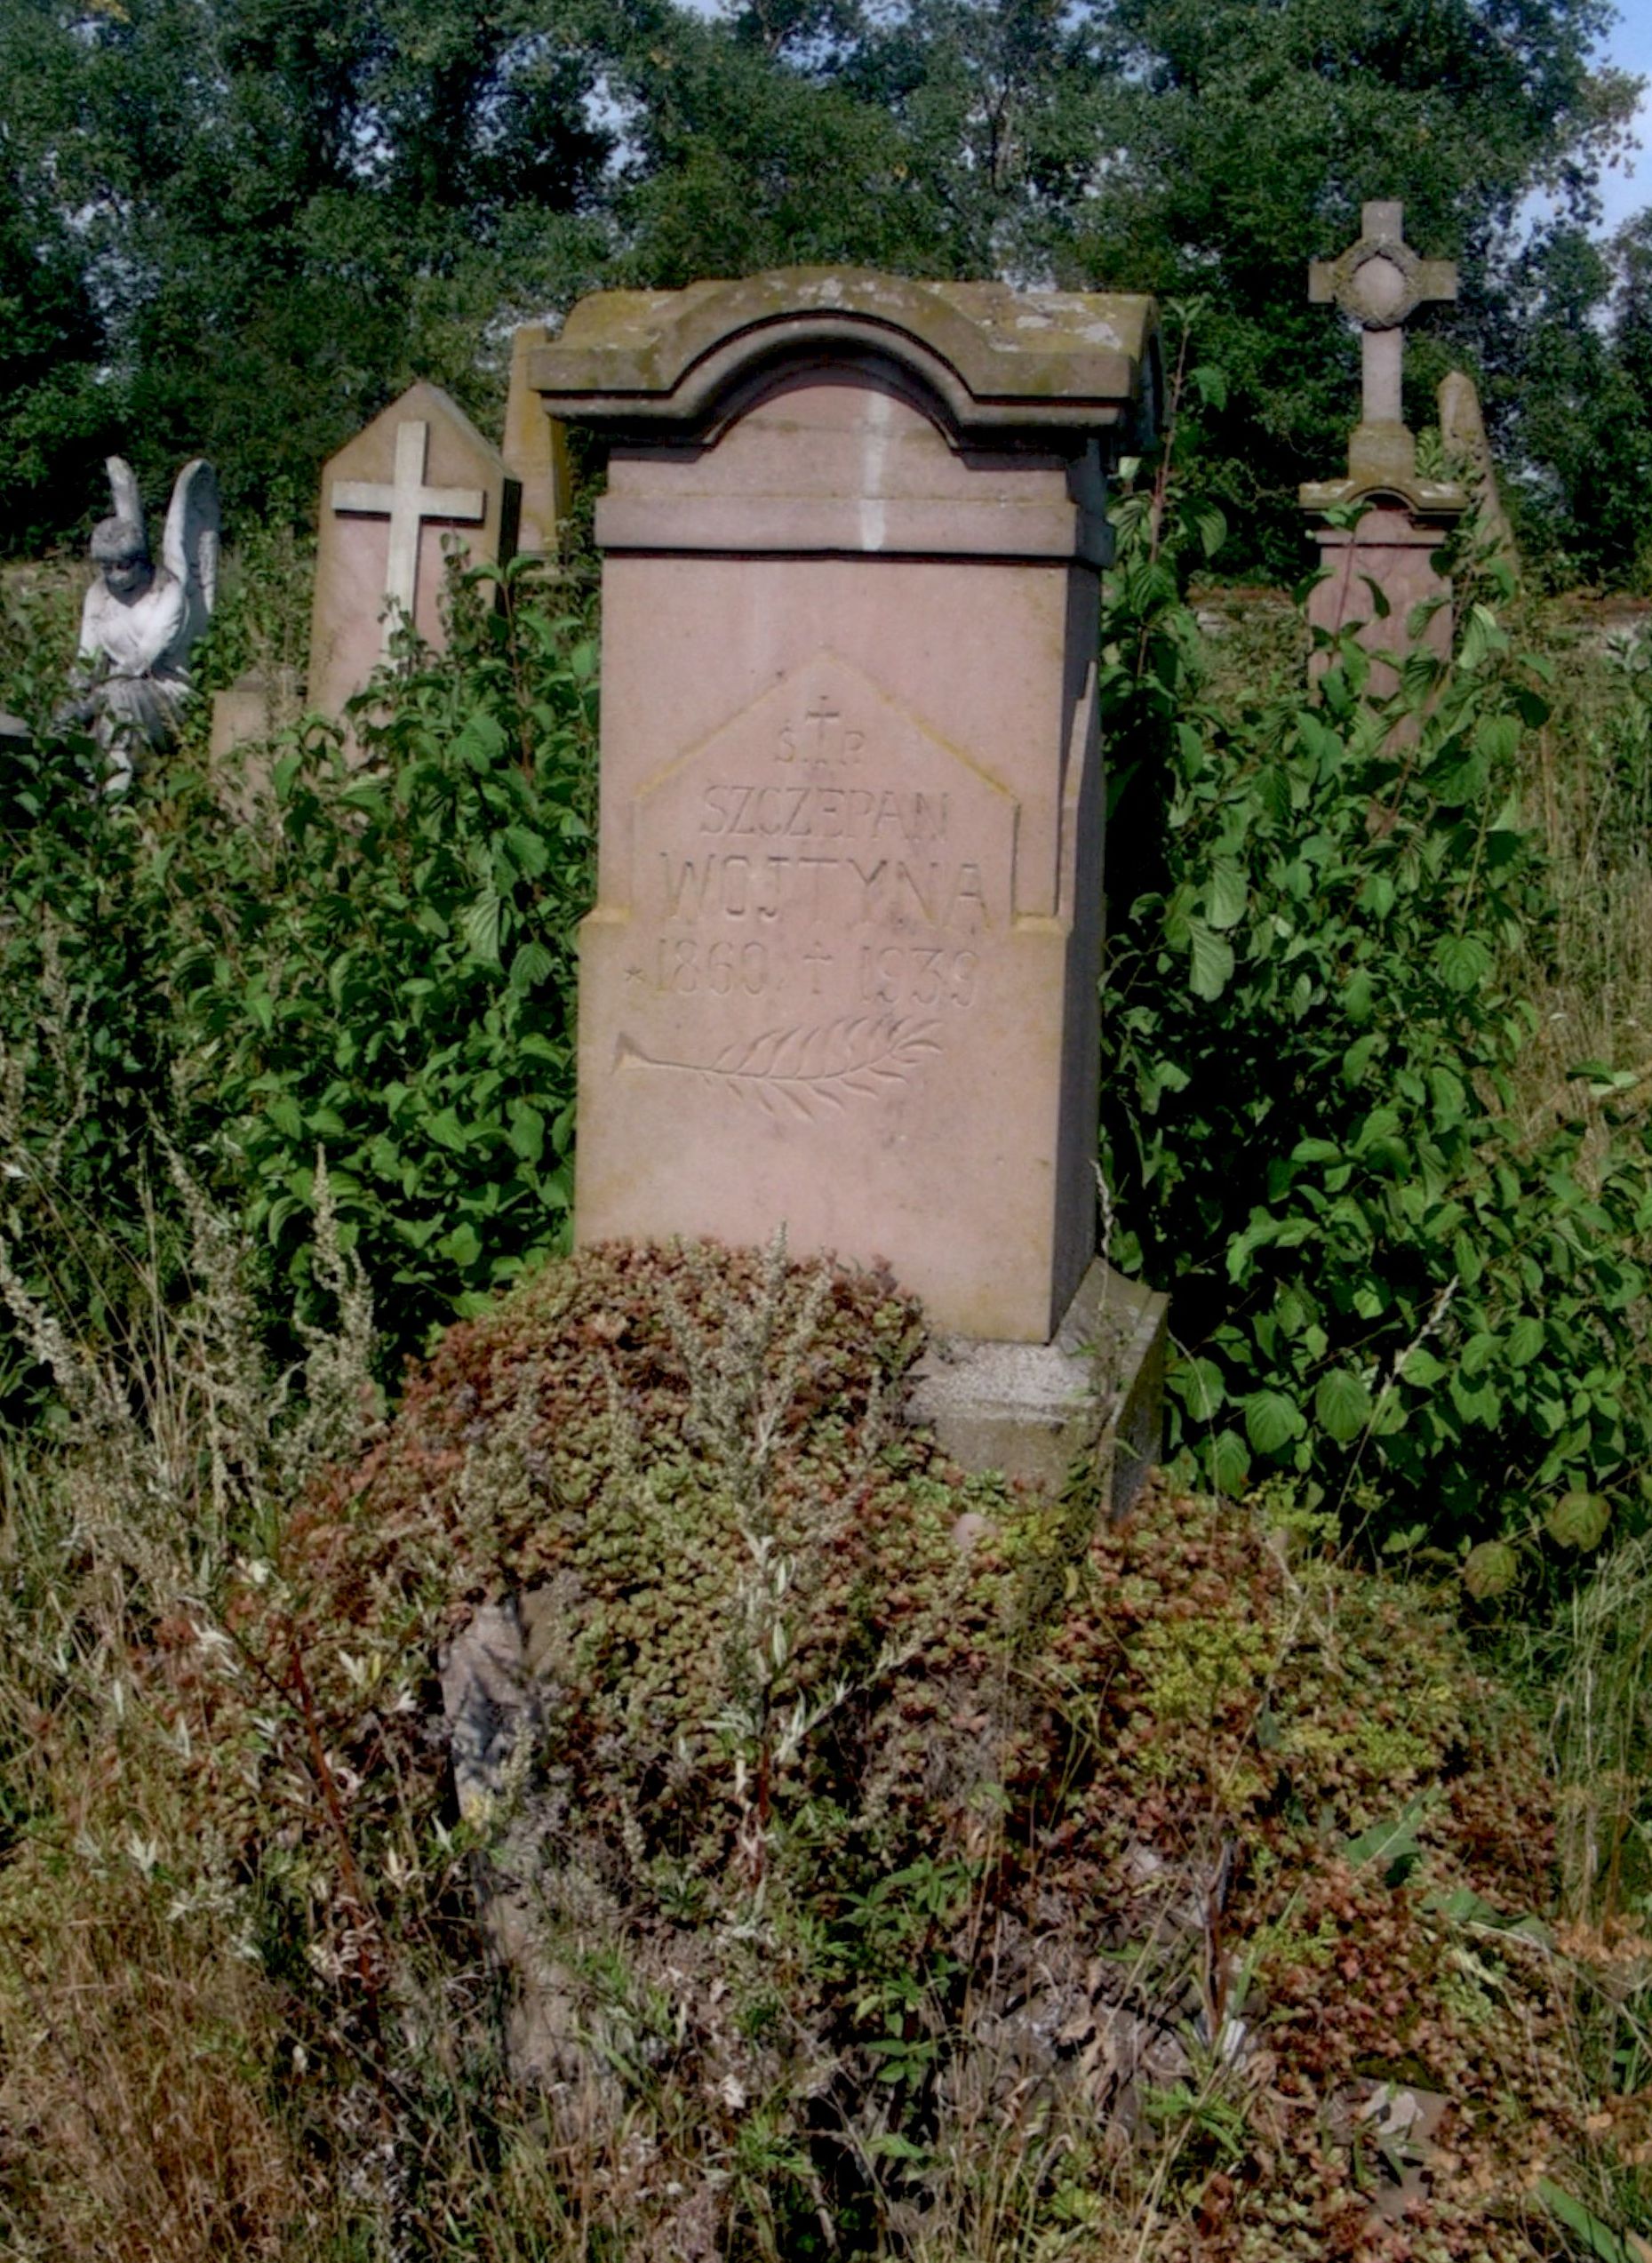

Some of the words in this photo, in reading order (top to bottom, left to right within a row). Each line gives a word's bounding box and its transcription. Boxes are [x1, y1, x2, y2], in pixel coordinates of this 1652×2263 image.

[699, 784, 950, 843] SZCZEPAN
[658, 852, 991, 929] WOJTYNA
[859, 945, 979, 1008] 1939
